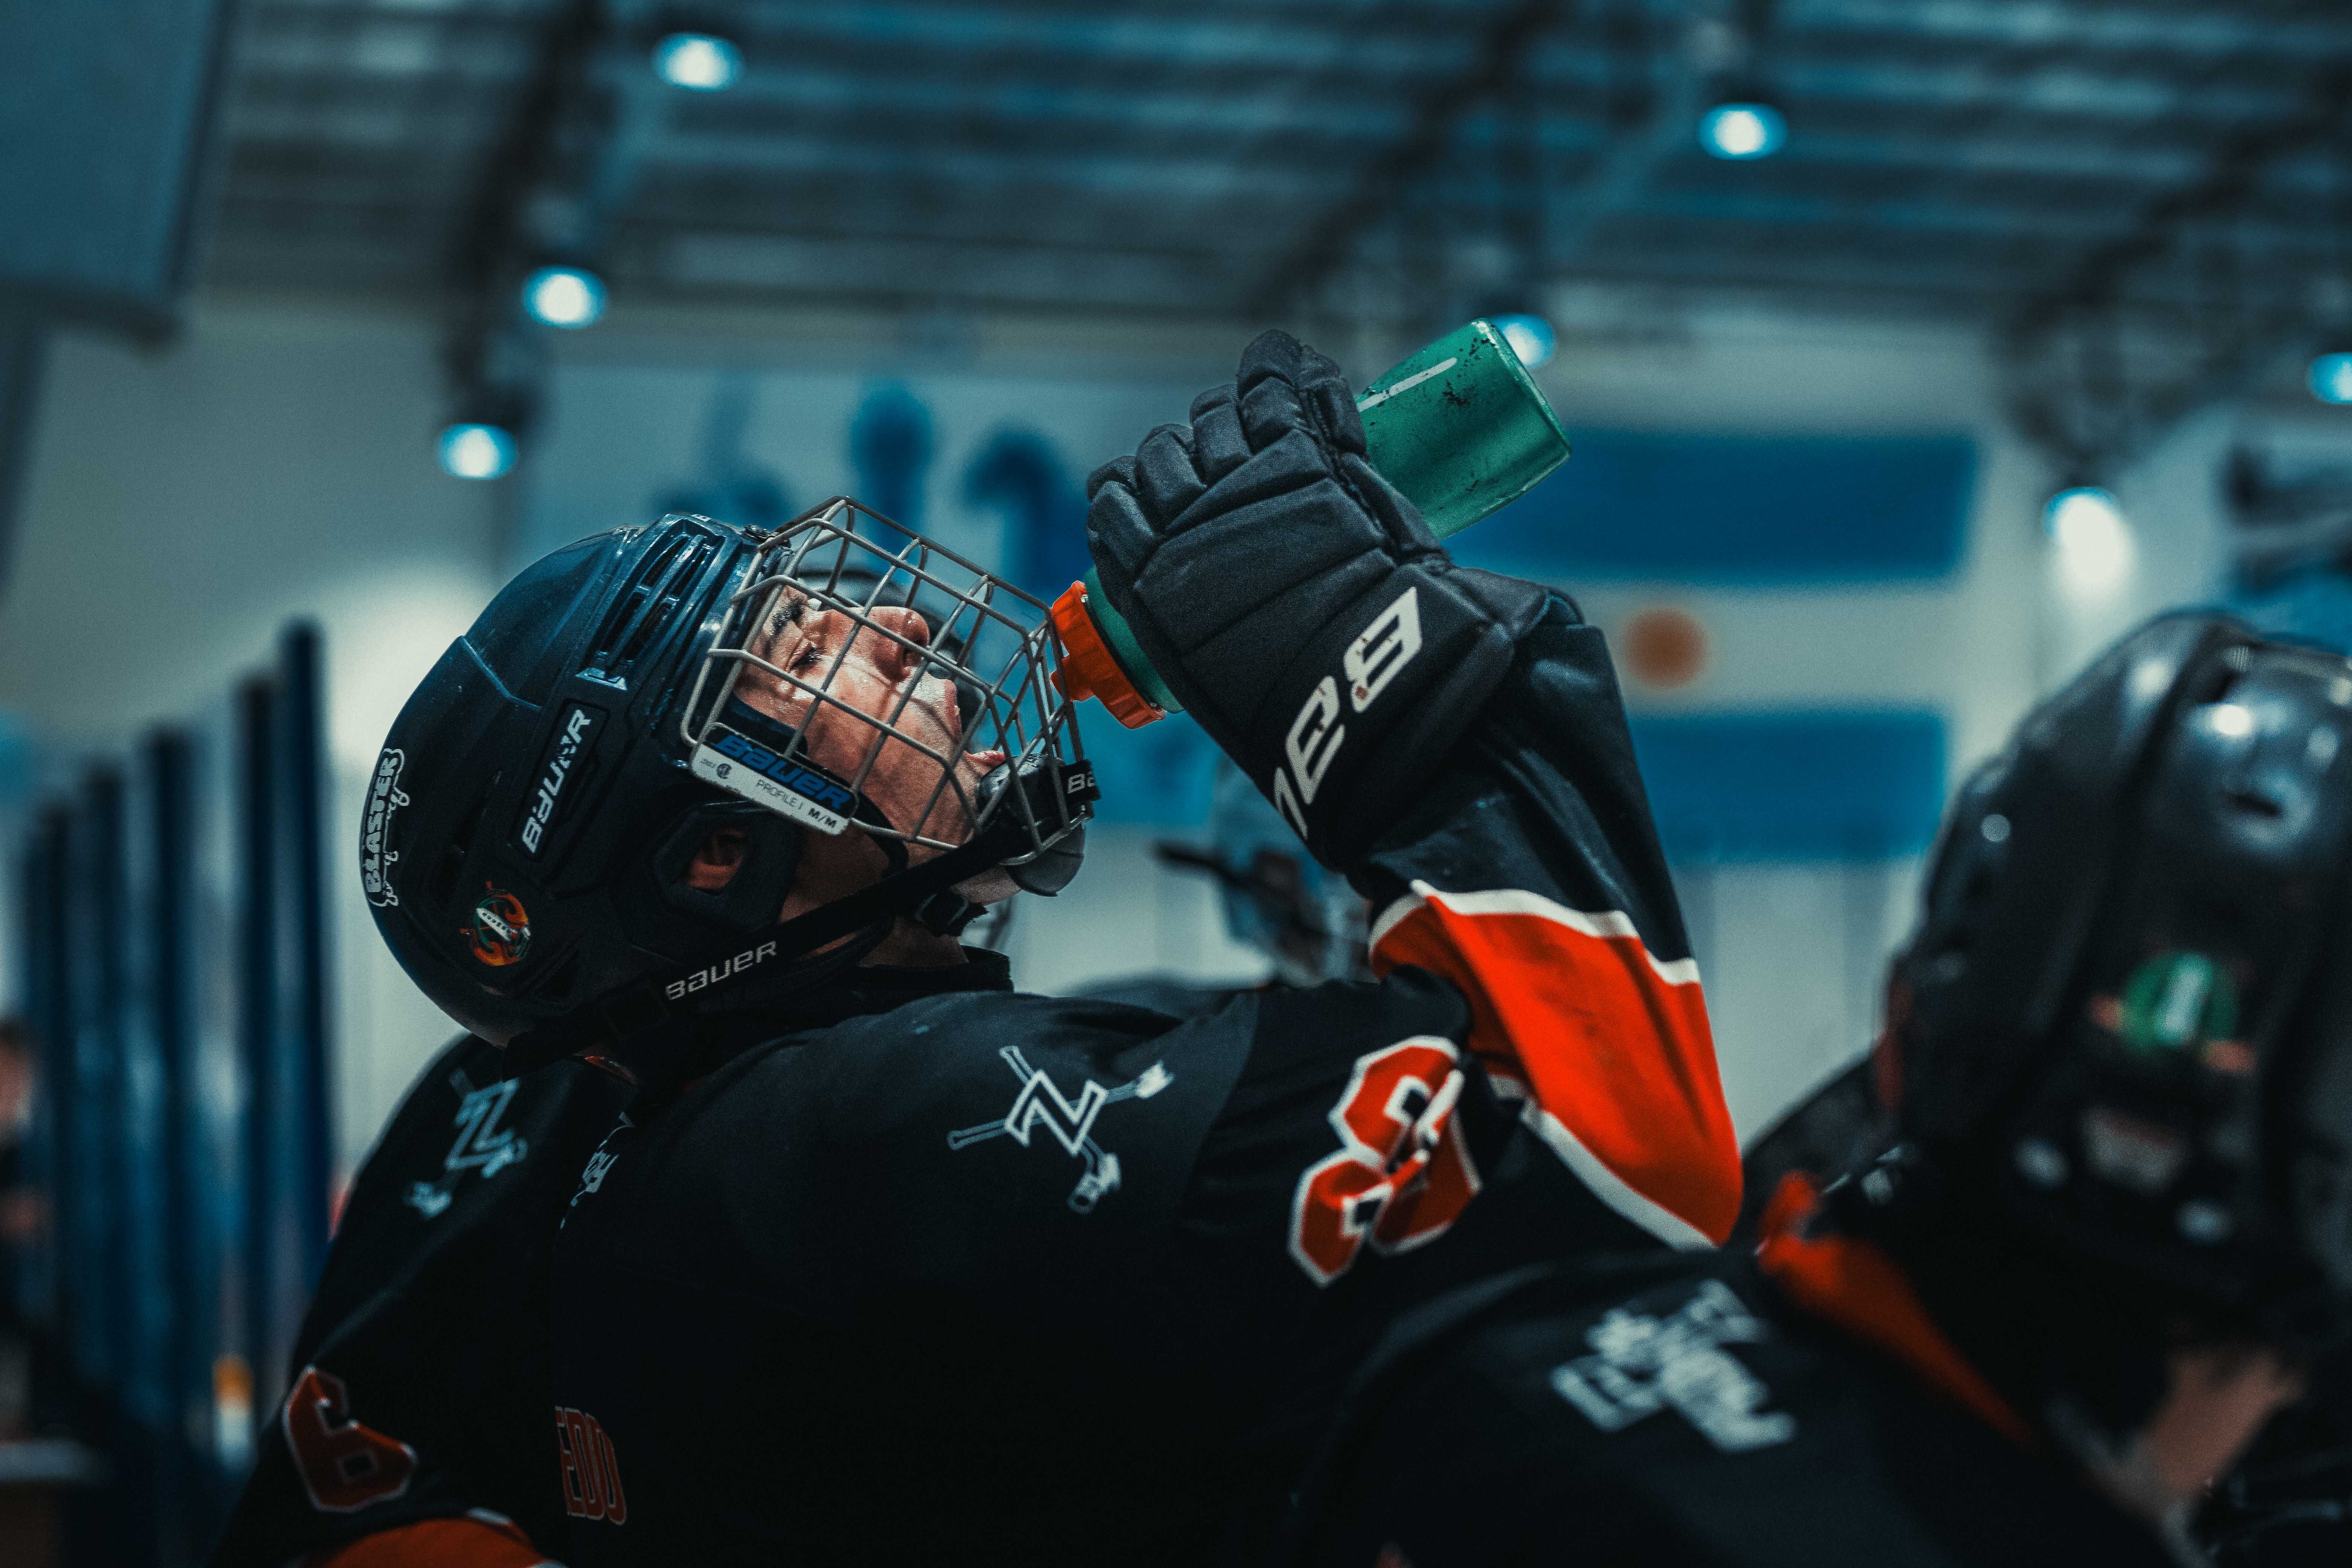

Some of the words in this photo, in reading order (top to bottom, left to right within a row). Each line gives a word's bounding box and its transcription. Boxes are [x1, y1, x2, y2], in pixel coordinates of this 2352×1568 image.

[713, 735, 852, 810] BAUER
[755, 779, 798, 808] PROFILE
[808, 808, 838, 828] M/M
[364, 756, 399, 893] BLASTER
[666, 940, 777, 1000] BAUER
[281, 1364, 419, 1513] 6
